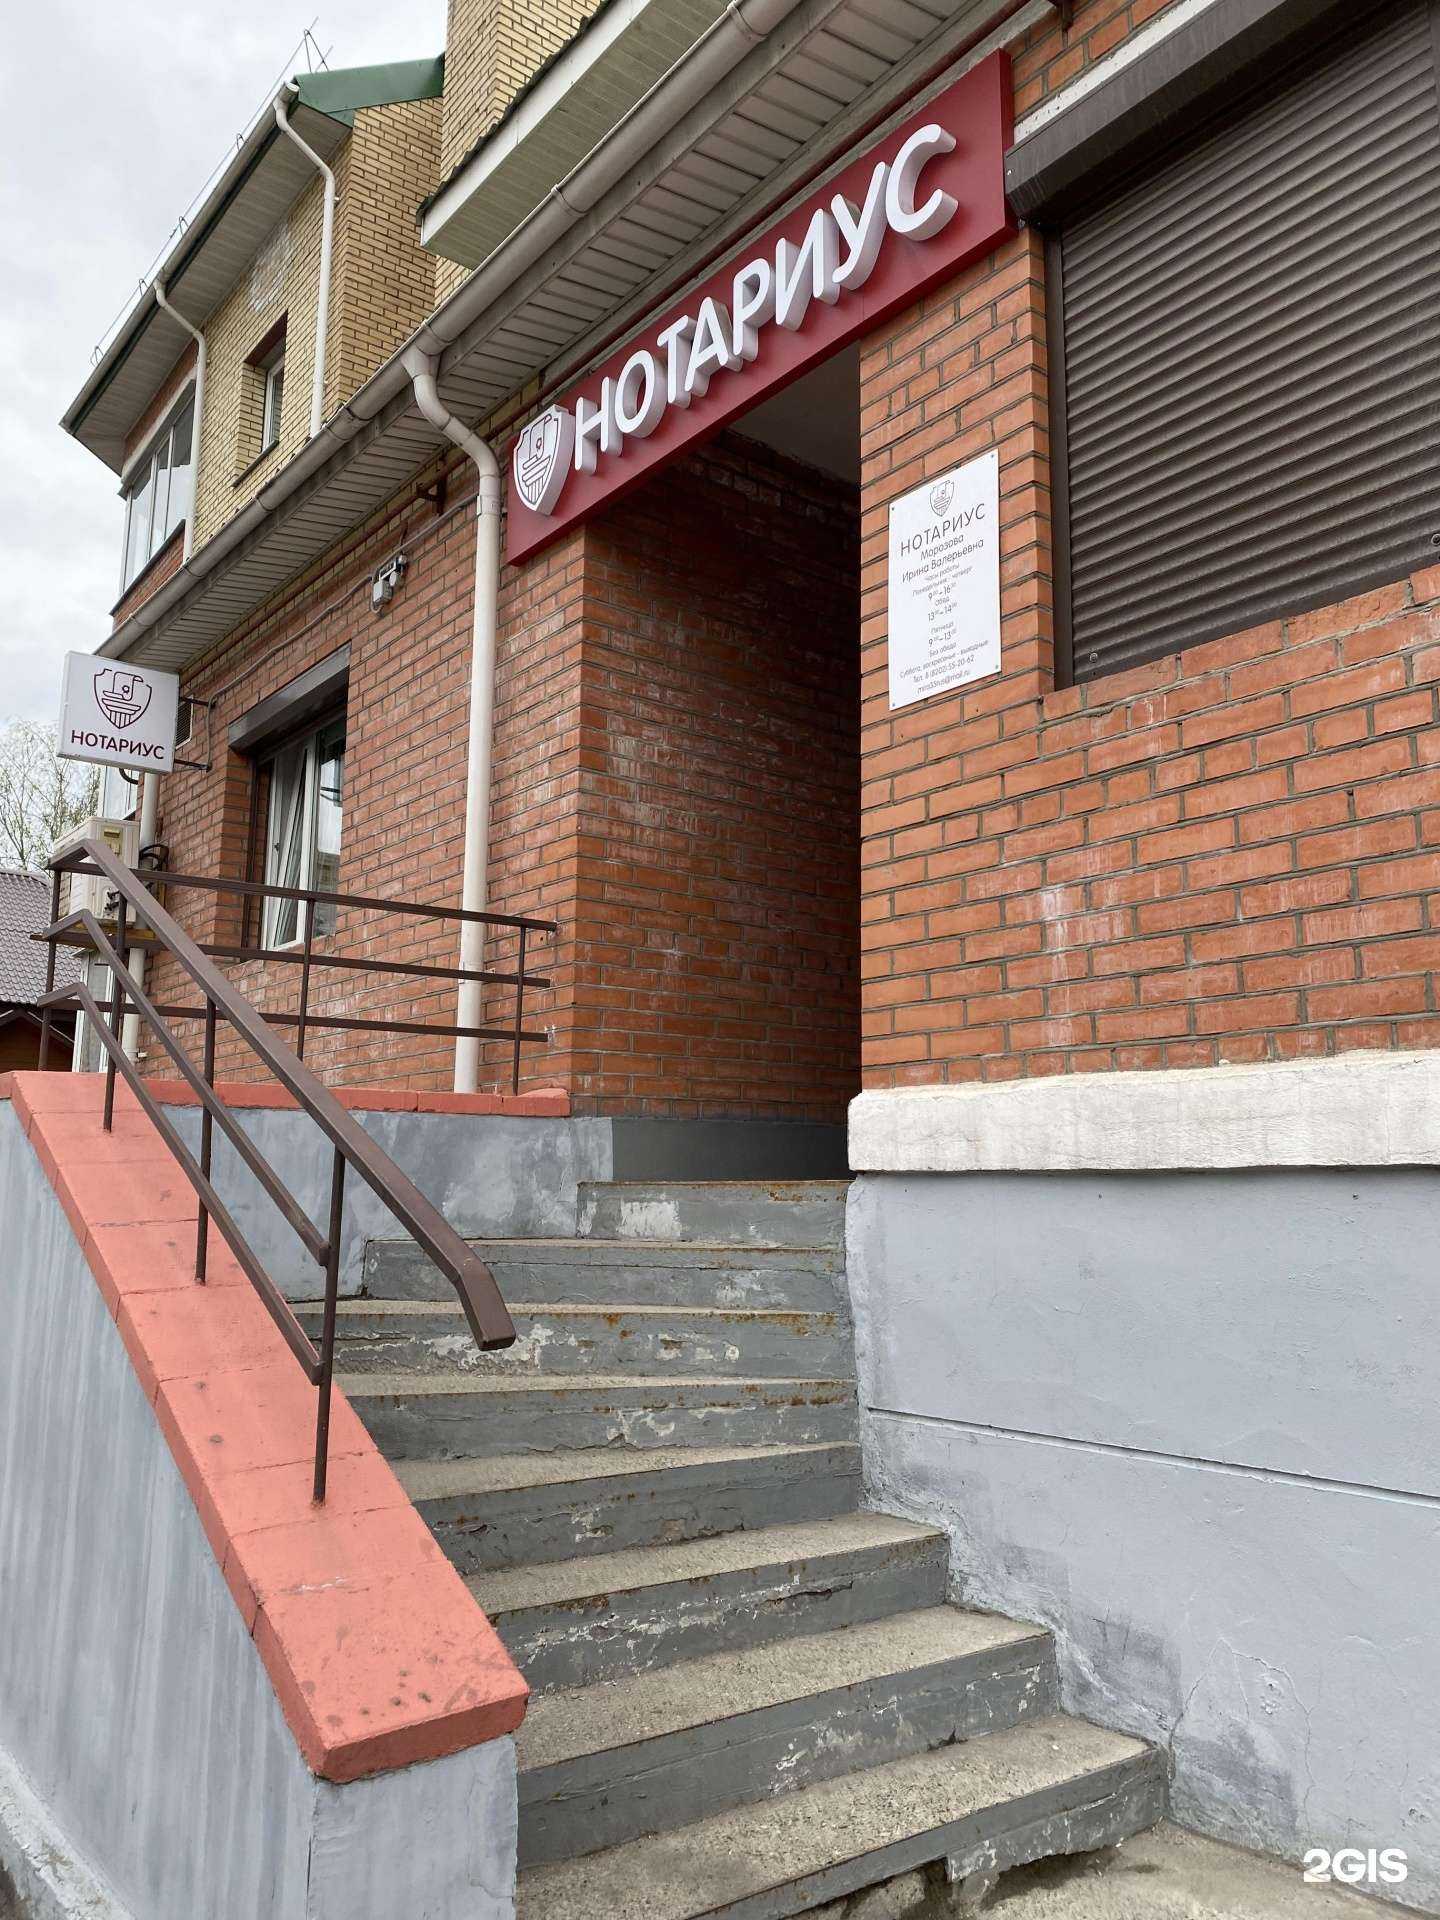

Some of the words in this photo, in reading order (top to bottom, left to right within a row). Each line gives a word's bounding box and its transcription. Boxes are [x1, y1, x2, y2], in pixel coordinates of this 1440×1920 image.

[575, 124, 958, 474] НОТАРИУС
[900, 503, 985, 556] НОТАРИУС
[920, 535, 963, 560] Морозова
[902, 563, 928, 582] Ирина
[931, 539, 983, 568] Валерьевна
[71, 729, 165, 760] НОТАРИУС
